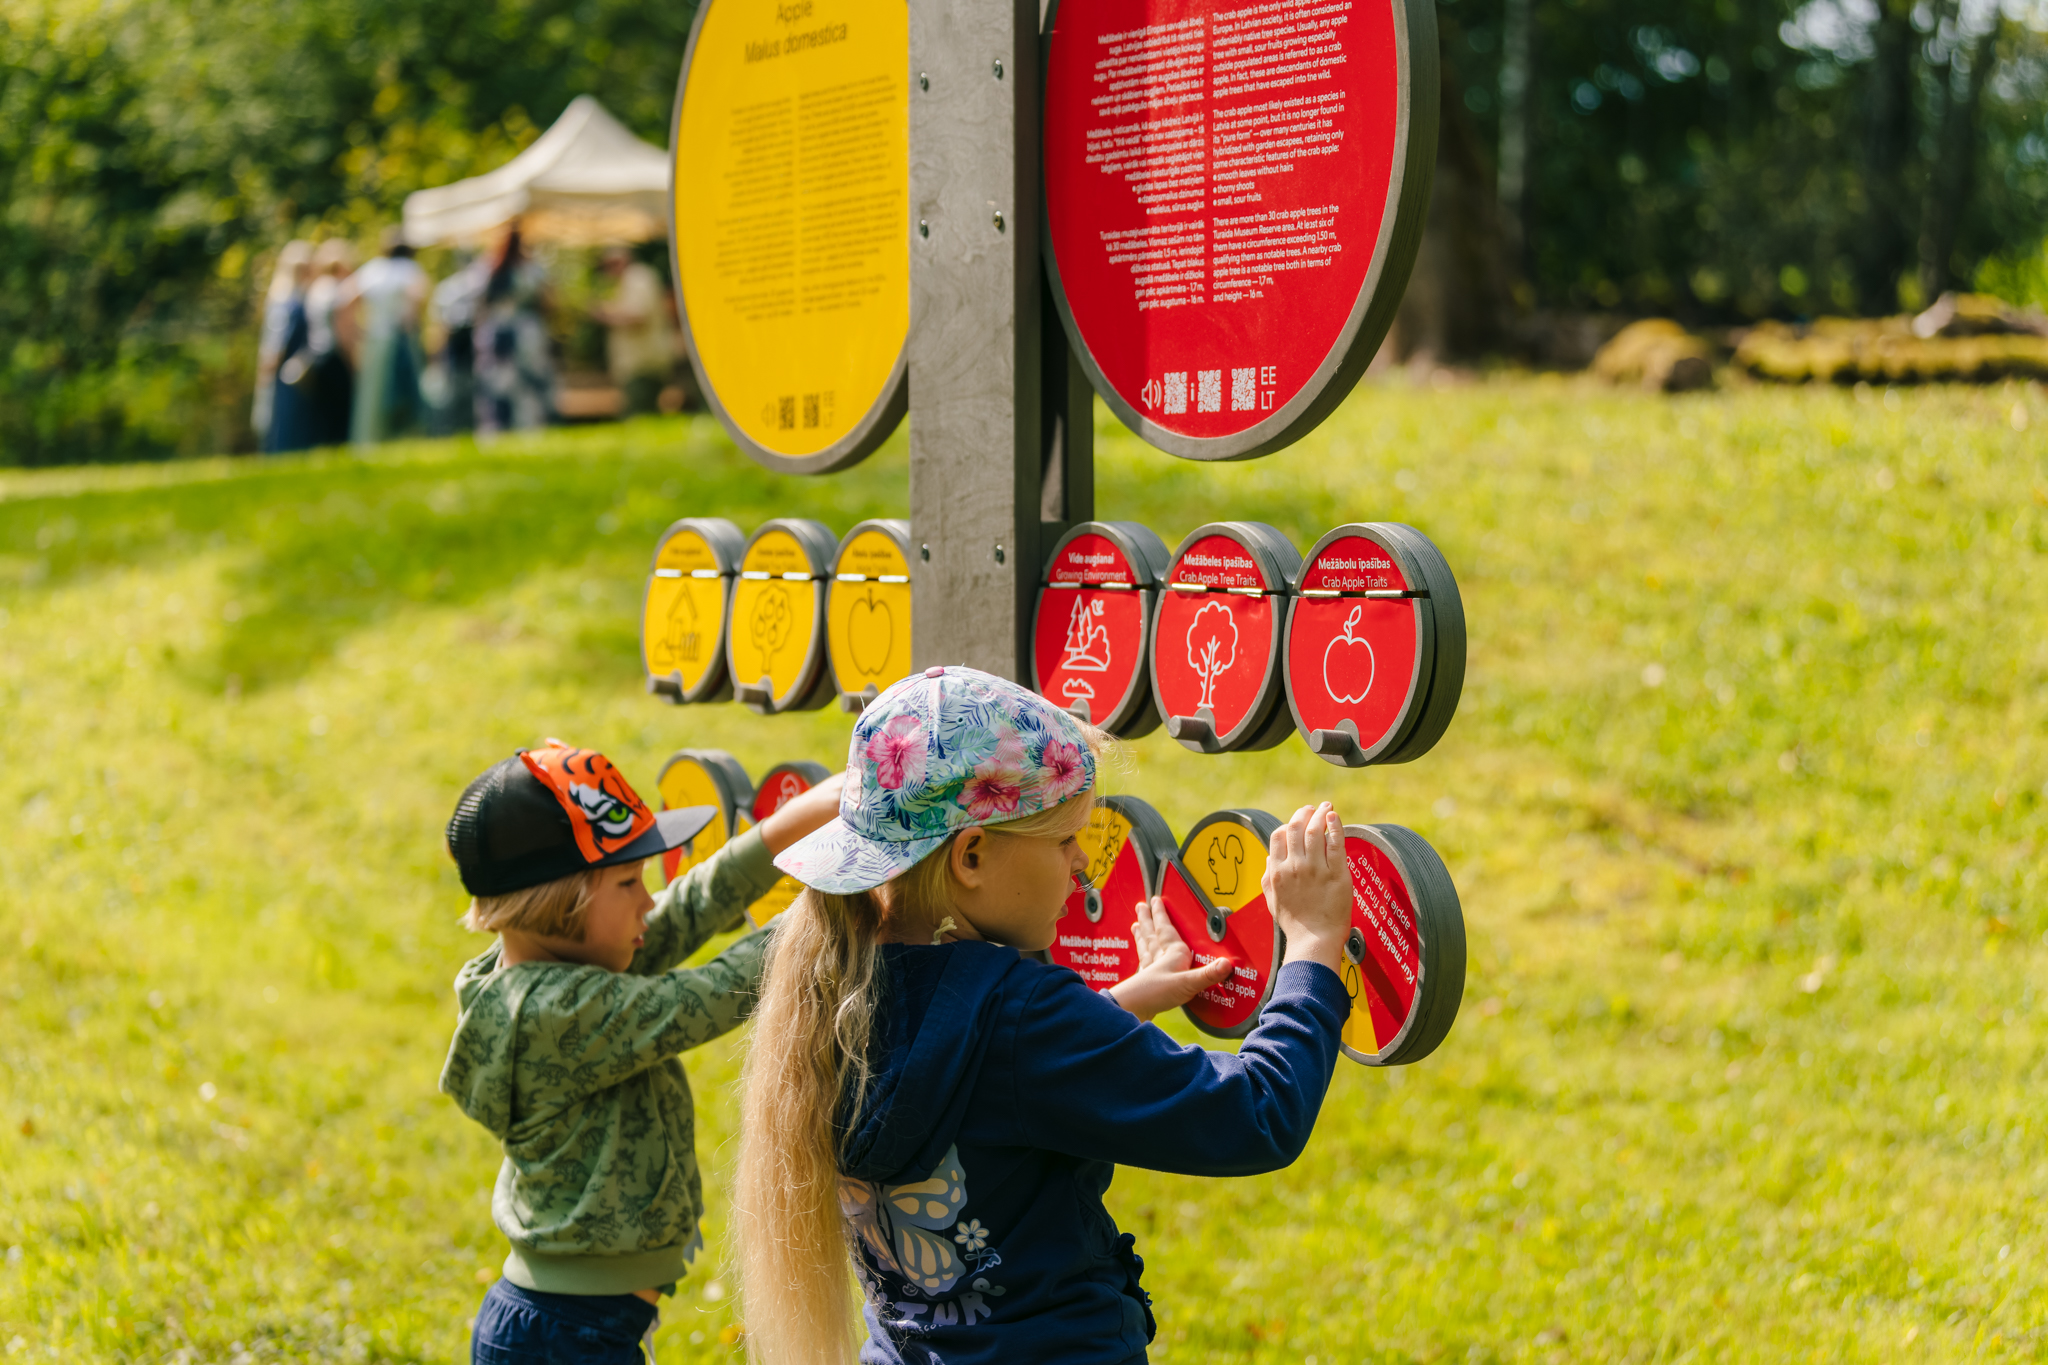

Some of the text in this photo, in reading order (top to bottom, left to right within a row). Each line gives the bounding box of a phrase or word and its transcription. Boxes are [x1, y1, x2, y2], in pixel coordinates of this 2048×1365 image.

[1212, 12, 1223, 21] The
[1223, 9, 1236, 19] crab
[1236, 6, 1252, 18] apple
[1252, 5, 1257, 14] is
[1258, 3, 1268, 12] the
[1268, 1, 1281, 11] only
[1213, 24, 1233, 34] Europe.
[1234, 21, 1239, 30] In
[1241, 18, 1261, 29] Latvian
[1284, 12, 1288, 20] it
[1289, 11, 1293, 19] is
[1294, 9, 1310, 18] often
[1311, 1, 1343, 15] considered
[1344, 1, 1351, 9] an
[744, 22, 847, 64] Malus domestica
[1213, 29, 1335, 59] tree with small, sour fruits growing especially
[1213, 74, 1229, 85] apple.
[1230, 73, 1235, 81] In
[1250, 69, 1265, 78] these
[1266, 67, 1275, 75] are
[1275, 61, 1311, 73] descendants
[1312, 57, 1318, 67] of
[1319, 53, 1346, 66] domestic
[1213, 109, 1223, 117] The
[1223, 107, 1236, 116] crab
[1237, 104, 1252, 116] apple
[1253, 102, 1267, 111] most
[1268, 99, 1282, 109] likely
[1283, 96, 1303, 107] existed
[1305, 96, 1311, 104] as
[1317, 91, 1338, 103] species
[1340, 89, 1345, 98] in
[1213, 120, 1229, 131] Latvia
[1230, 120, 1236, 128] at
[1237, 118, 1252, 127] some
[1253, 115, 1269, 126] point,
[1270, 113, 1280, 122] but
[1281, 111, 1285, 120] it
[1286, 111, 1291, 119] is
[1300, 108, 1319, 118] longer
[1320, 103, 1337, 114] found
[1338, 103, 1344, 111] in
[1213, 129, 1343, 157] hybridized with garden escapees, retaining only
[1217, 162, 1293, 180] smooth leaves without hairs
[1217, 181, 1254, 192] thorny shoots
[1217, 192, 1261, 205] small, sour fruits
[1213, 217, 1228, 225] There
[1254, 213, 1267, 221] than
[1268, 210, 1275, 220] 30
[1276, 209, 1288, 219] crab
[1290, 207, 1305, 219] apple
[1306, 207, 1321, 215] trees
[1322, 205, 1327, 213] in
[1328, 204, 1338, 212] the
[1213, 229, 1232, 238] Turaida
[1234, 228, 1257, 236] Museum
[1259, 225, 1281, 233] Reserve
[1282, 223, 1295, 231] area.
[1295, 221, 1302, 229] At
[1318, 218, 1326, 227] six
[1327, 216, 1333, 226] of
[1213, 243, 1227, 251] them
[1228, 241, 1241, 249] have
[1246, 237, 1286, 247] circumference
[1286, 232, 1315, 243] exceeding
[1213, 267, 1228, 277] apple
[1241, 265, 1245, 273] is
[1251, 263, 1272, 272] notable
[1273, 262, 1284, 270] tree
[1286, 260, 1299, 269] both
[1300, 259, 1305, 267] in
[1307, 259, 1323, 267] terms
[1324, 256, 1331, 265] of
[1261, 366, 1276, 385] EE
[1261, 391, 1275, 410] LT
[1068, 552, 1083, 564] Vide
[1183, 554, 1253, 570] Mežābeles īpašības
[1318, 557, 1391, 573] Mežābolu īpašības
[1056, 568, 1126, 584] Growing Environment
[1179, 571, 1257, 586] Crab Apple Tree Traits
[1322, 576, 1388, 591] Crab Apple Traits
[1358, 854, 1411, 930] apple in nature?
[1346, 856, 1410, 955] Where to find a crab
[1060, 935, 1129, 951] Mežābele gadalaikos
[1353, 885, 1415, 985] Kur meklēt mežābe
[1070, 951, 1120, 967] The Crab Apple
[1091, 969, 1119, 982] Seasons
[1234, 966, 1258, 981] mežā?
[1211, 990, 1235, 1008] forest?
[1235, 984, 1256, 998] apple
